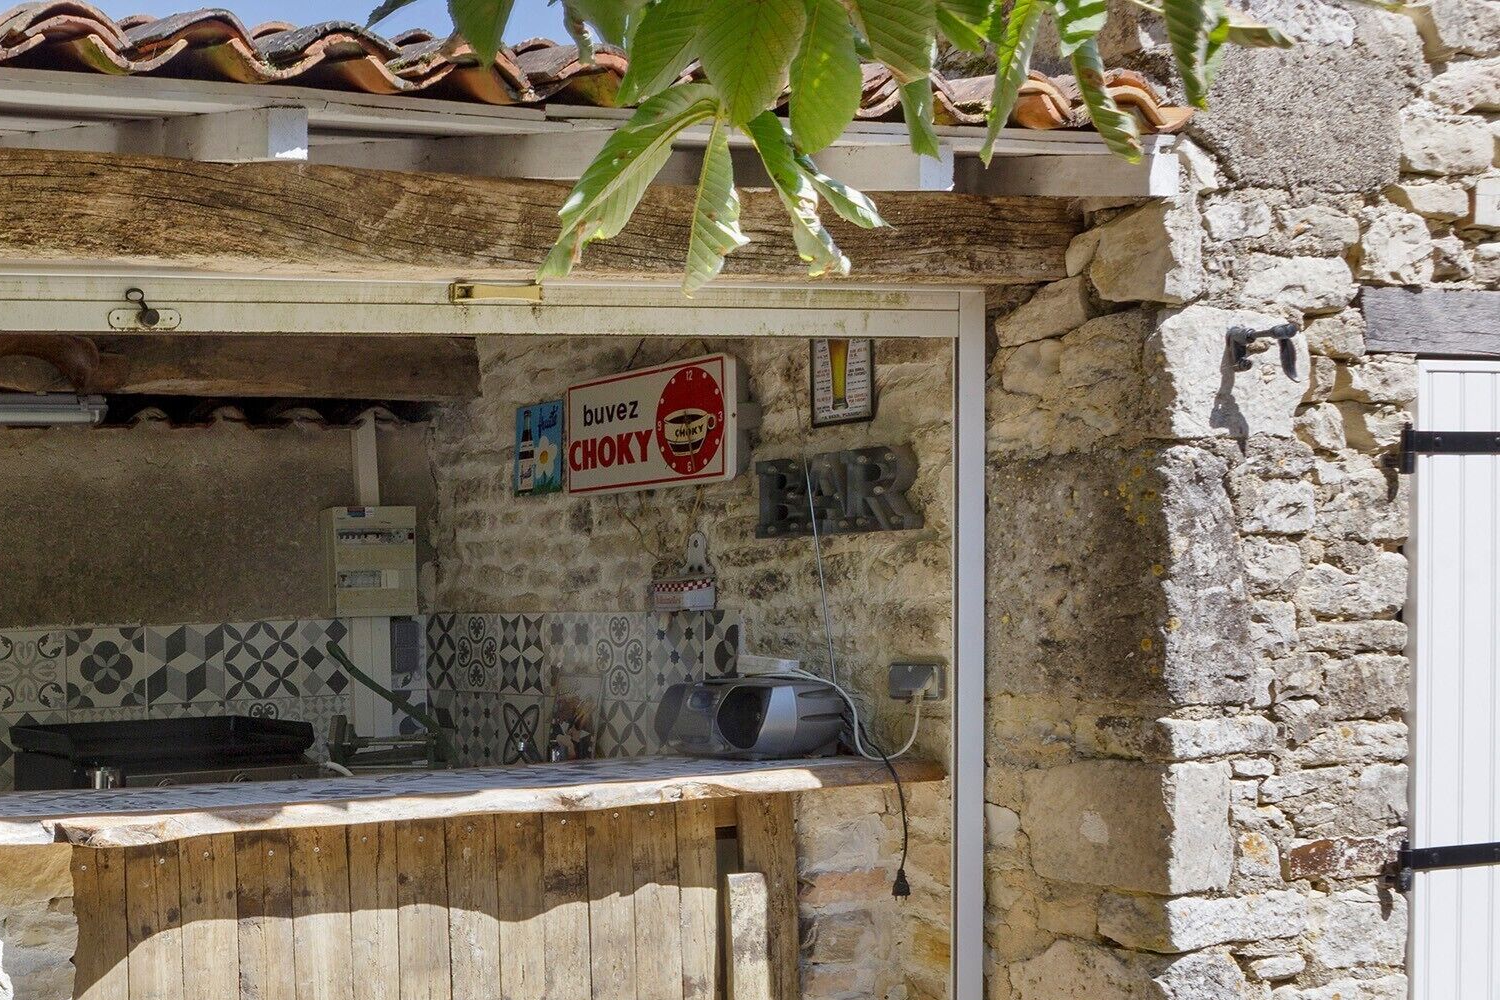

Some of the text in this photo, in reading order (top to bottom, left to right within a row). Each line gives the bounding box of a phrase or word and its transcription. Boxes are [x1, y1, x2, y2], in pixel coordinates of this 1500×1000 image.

[685, 370, 693, 381] 12
[583, 400, 639, 427] buvez
[717, 412, 723, 421] 3
[657, 420, 662, 431] 9
[674, 424, 704, 437] CHOKY
[569, 429, 654, 472] CHOKY
[686, 463, 692, 472] 6
[756, 444, 925, 539] BAR
